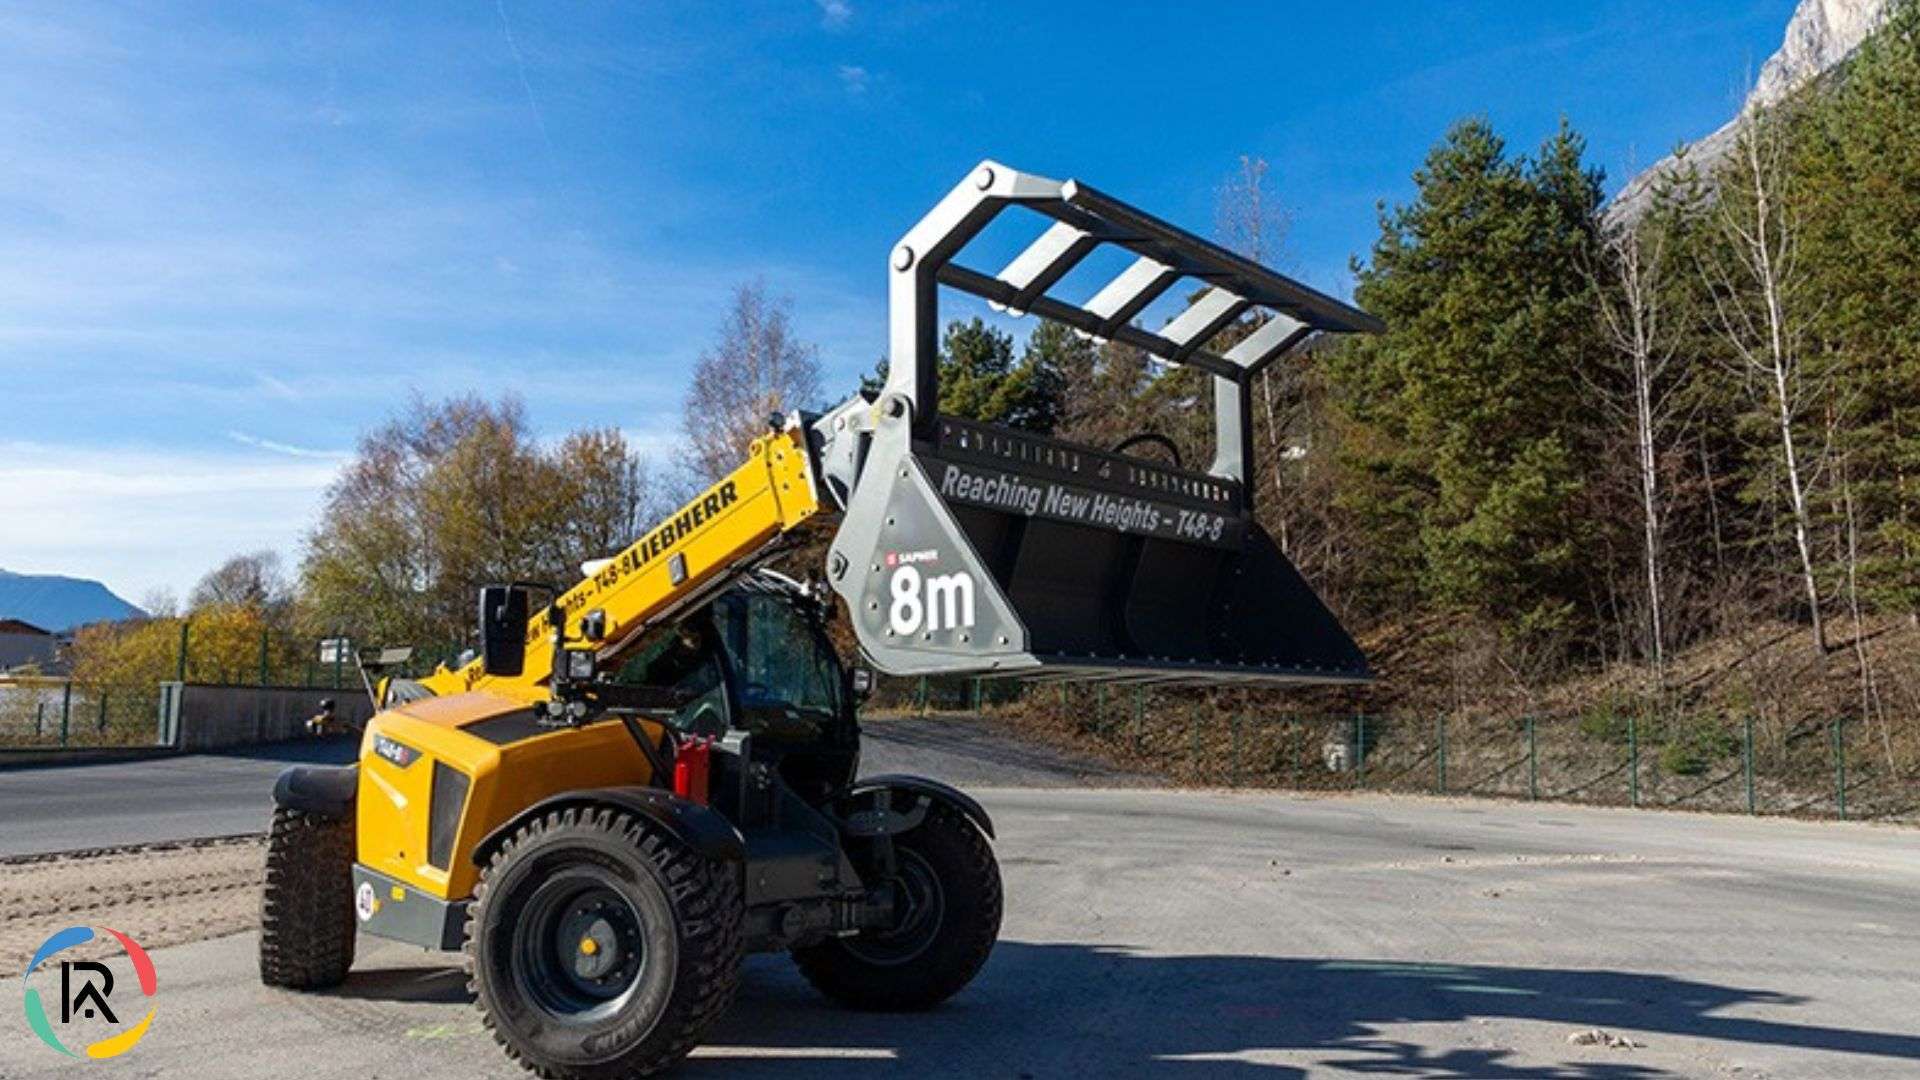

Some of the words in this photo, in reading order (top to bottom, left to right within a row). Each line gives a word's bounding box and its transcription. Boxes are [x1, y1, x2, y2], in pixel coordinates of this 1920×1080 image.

[631, 480, 738, 571] LIEBHERR
[941, 464, 1041, 516] Reaching
[1043, 484, 1090, 519] New
[1089, 493, 1160, 531] Heights
[1176, 509, 1225, 541] T48-8
[890, 565, 975, 635] 8m
